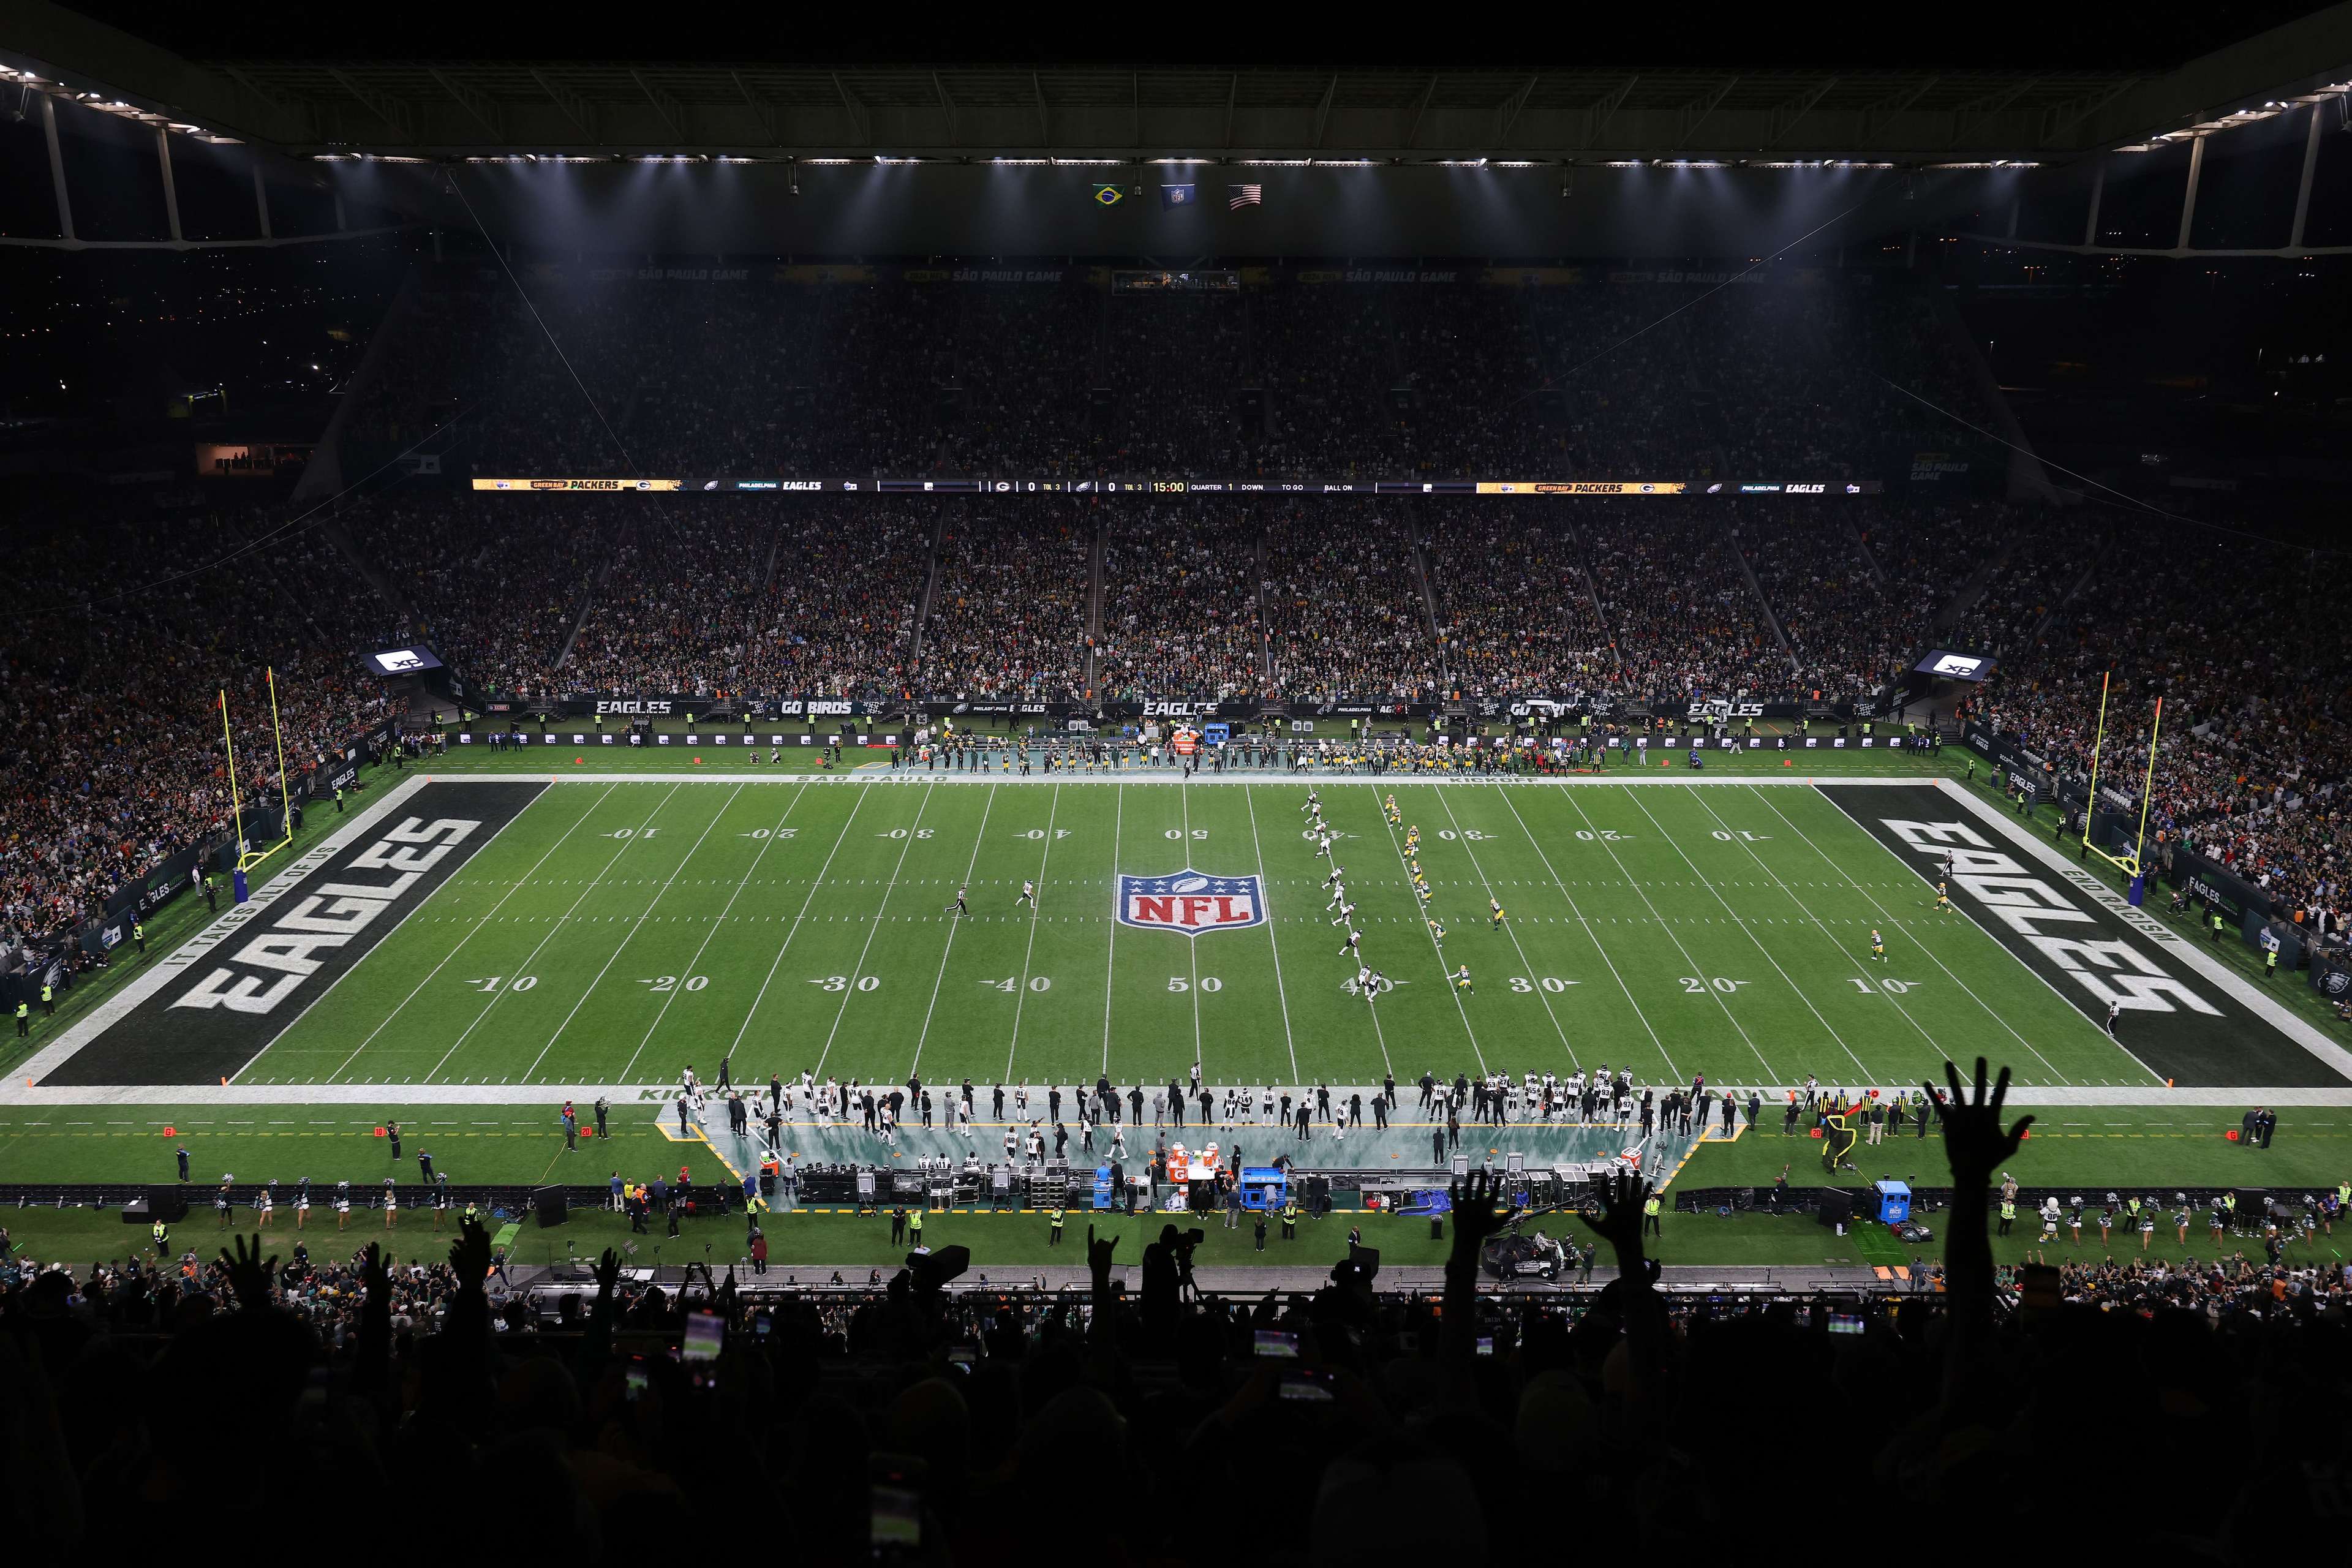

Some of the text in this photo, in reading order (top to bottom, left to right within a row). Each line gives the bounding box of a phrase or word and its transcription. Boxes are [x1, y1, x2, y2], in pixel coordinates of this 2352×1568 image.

[952, 268, 1063, 282] SÃO PAULO GAME
[1346, 268, 1457, 282] SÃO PAULO GAME
[571, 481, 618, 489] PACKERS
[783, 481, 821, 490] EAGLES
[1028, 482, 1035, 491] 0
[1108, 482, 1115, 491] 0
[1153, 482, 1184, 492] 15:00
[1785, 484, 1825, 493] EAGLES
[597, 701, 672, 714] EAGLES
[781, 701, 853, 714] GO BIRDS
[1510, 703, 1531, 715] GO
[1976, 739, 1989, 750] EAGLES
[331, 767, 355, 790] EAGLES
[2009, 772, 2036, 793] EAGLES
[2189, 876, 2220, 903] EAGLES
[139, 883, 170, 911] EGLES
[164, 846, 337, 965] IT TAKES ALL OF US
[1135, 897, 1249, 926] NFL
[2062, 870, 2180, 942] END RACISM
[163, 816, 483, 1015] EAGLES
[1877, 818, 2227, 1018] EAGLES
